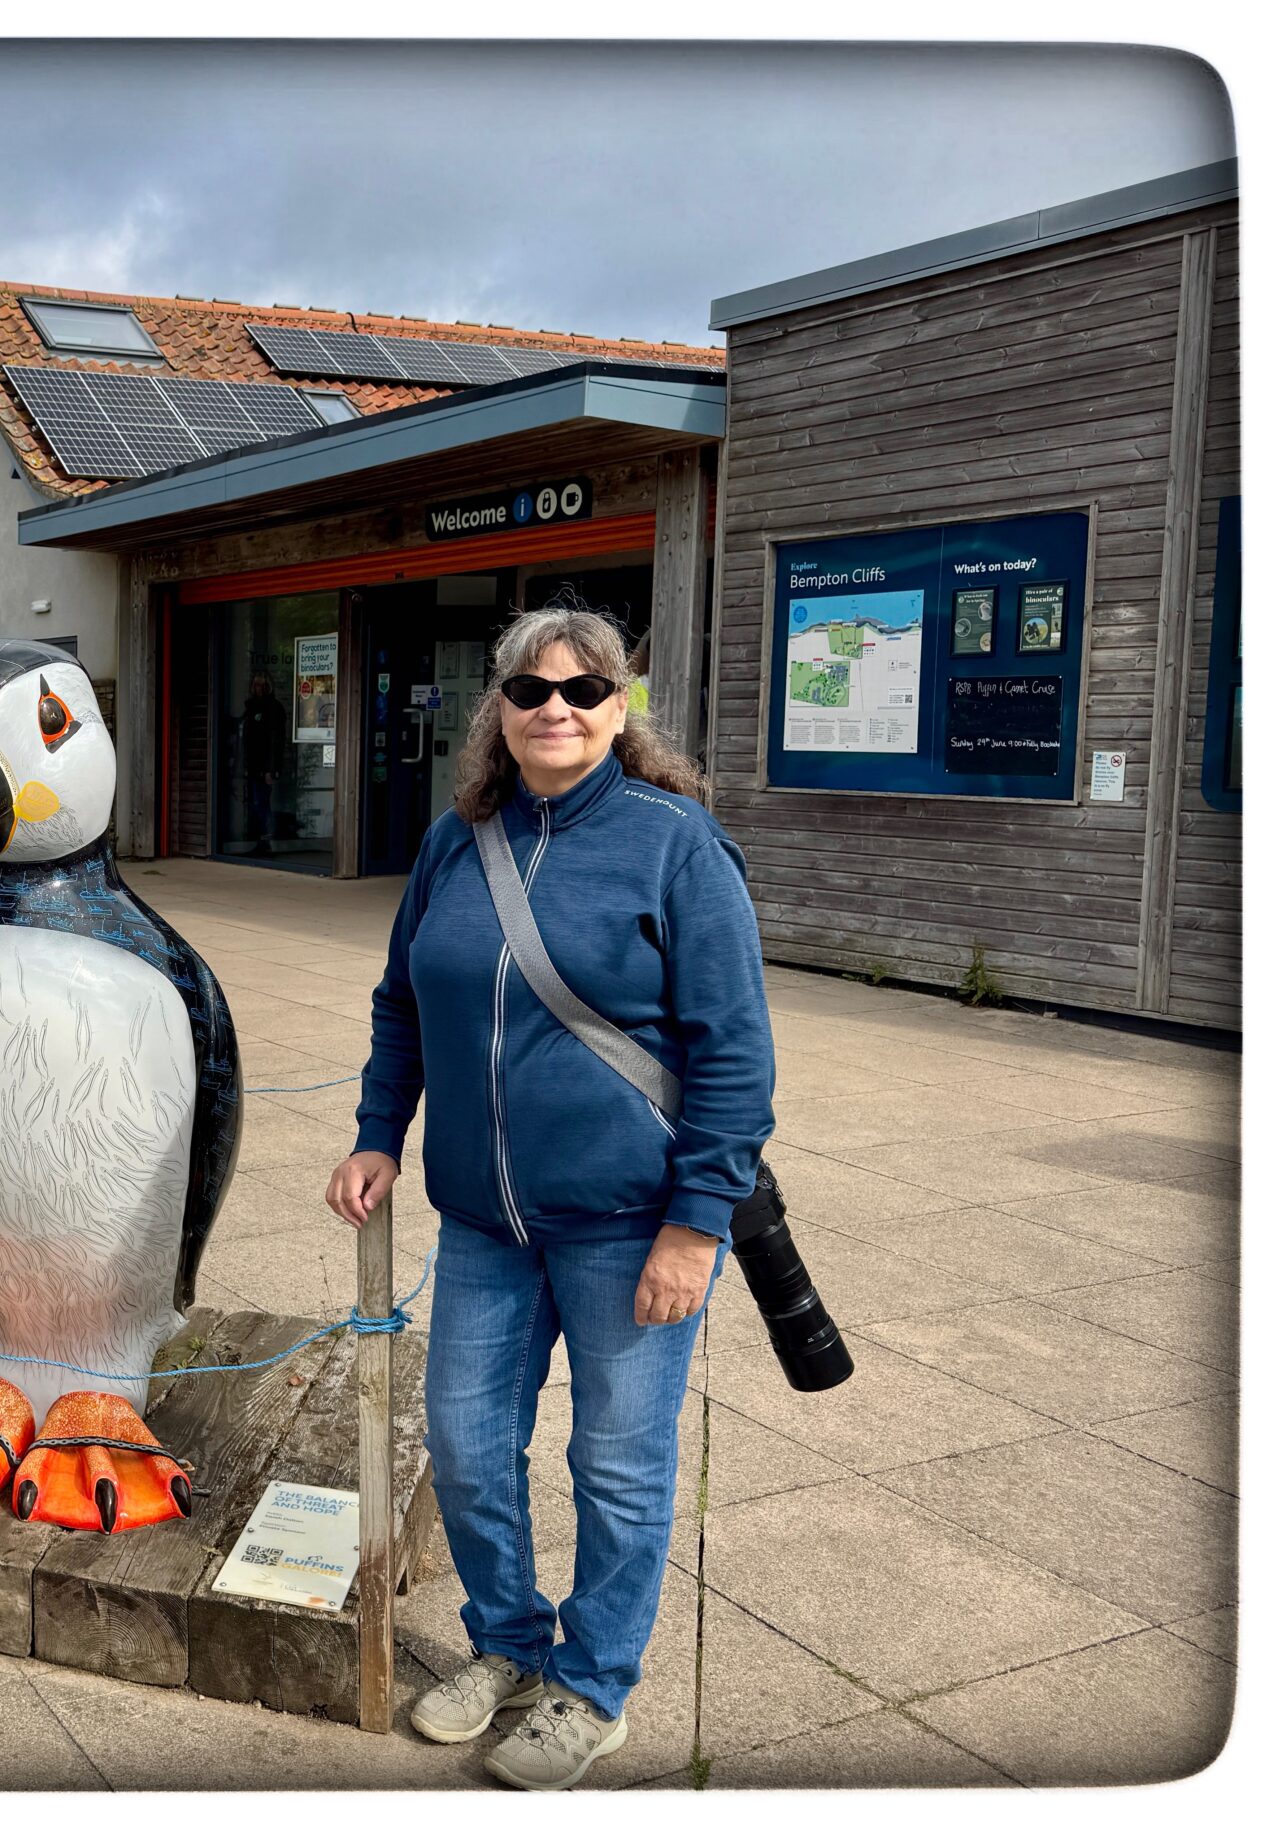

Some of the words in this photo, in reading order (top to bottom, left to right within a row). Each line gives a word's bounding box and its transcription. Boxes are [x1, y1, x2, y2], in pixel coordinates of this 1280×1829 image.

[432, 506, 507, 533] Welcome
[791, 562, 818, 572] Explore
[954, 562, 986, 574] What's
[988, 563, 1001, 572] on
[1003, 558, 1037, 571] today?
[790, 573, 848, 590] Bempton
[852, 566, 886, 583] Cliffs
[1025, 596, 1059, 605] binoculars
[301, 644, 330, 654] Forgotten
[301, 653, 316, 663] bring
[301, 662, 333, 673] binoculars?
[955, 681, 971, 695] RSPB
[977, 681, 997, 697] Puffin
[1032, 680, 1056, 695] Cruise
[950, 736, 974, 751] Sunday
[991, 740, 1007, 748] June
[278, 1490, 303, 1499] THE
[306, 1494, 359, 1507] BALANC
[296, 1498, 347, 1511] THREAT
[271, 1502, 300, 1510] AND
[303, 1506, 341, 1516] HOPE
[284, 1557, 344, 1572] PUFFINS
